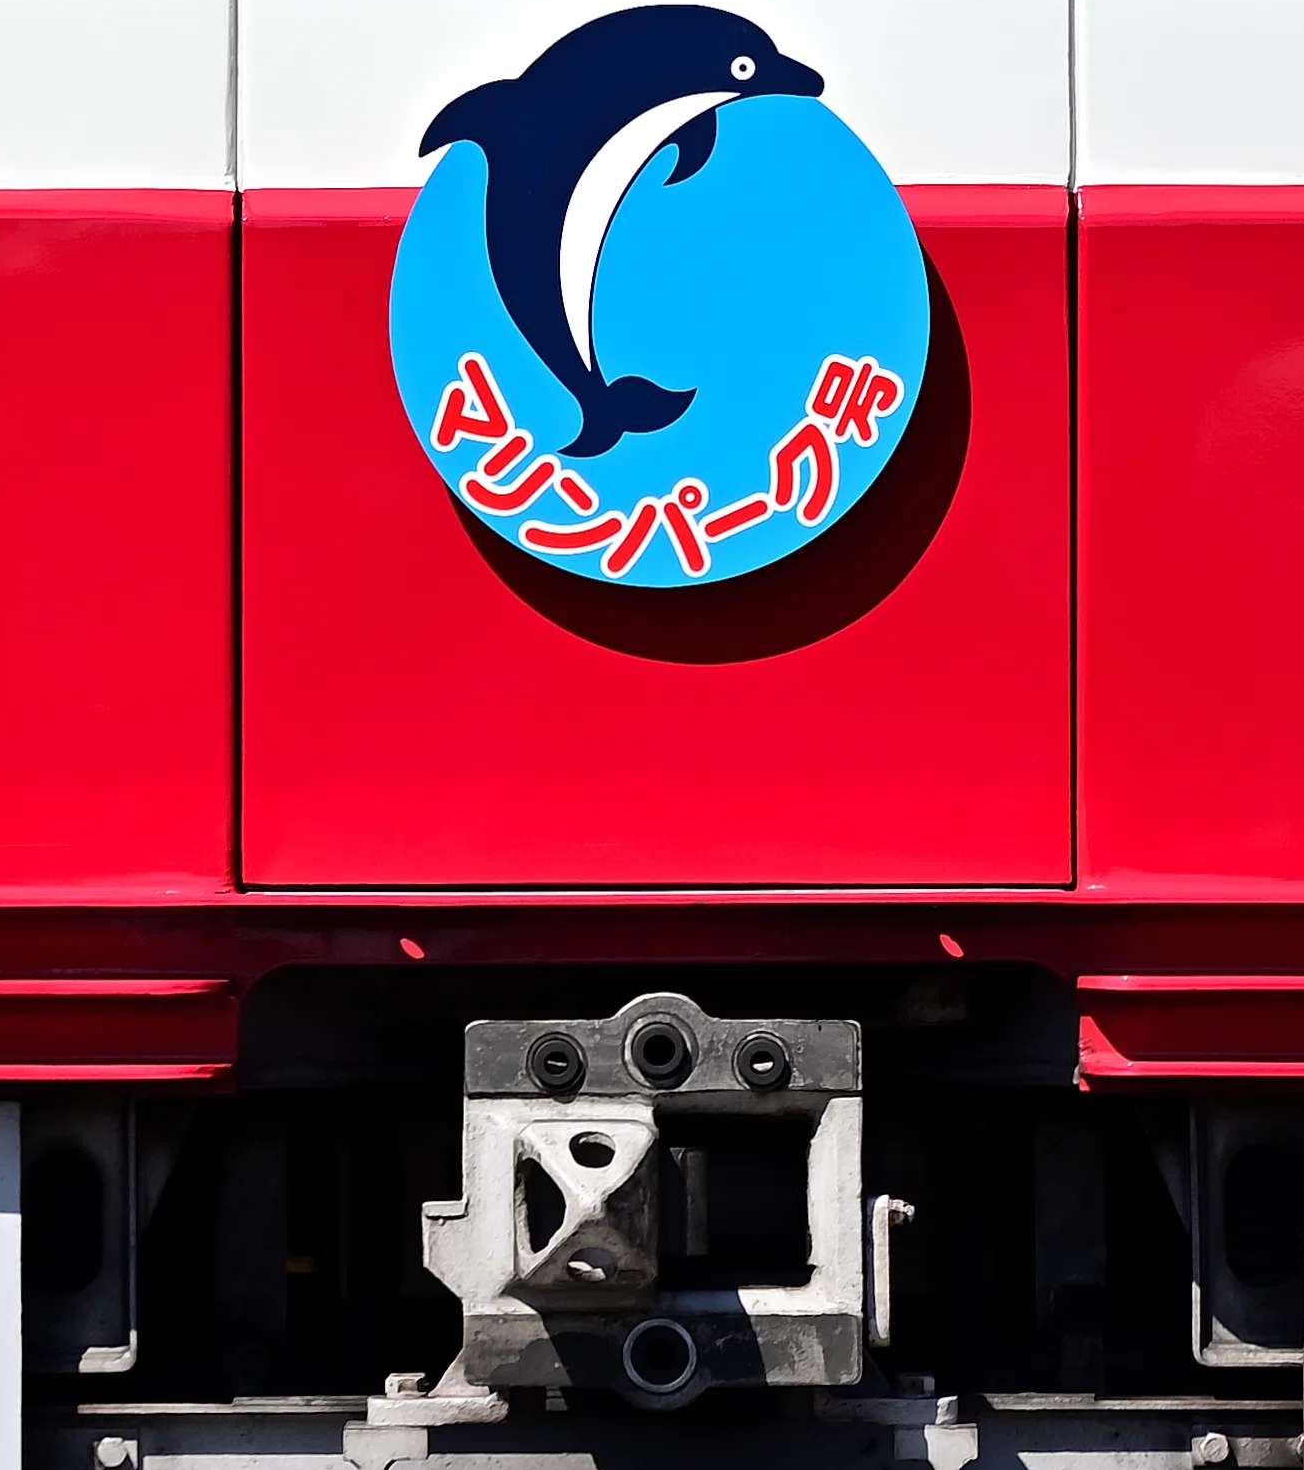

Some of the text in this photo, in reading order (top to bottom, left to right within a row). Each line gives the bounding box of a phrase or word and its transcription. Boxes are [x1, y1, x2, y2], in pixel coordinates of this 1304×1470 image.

[433, 353, 905, 577] マリンパーク号
